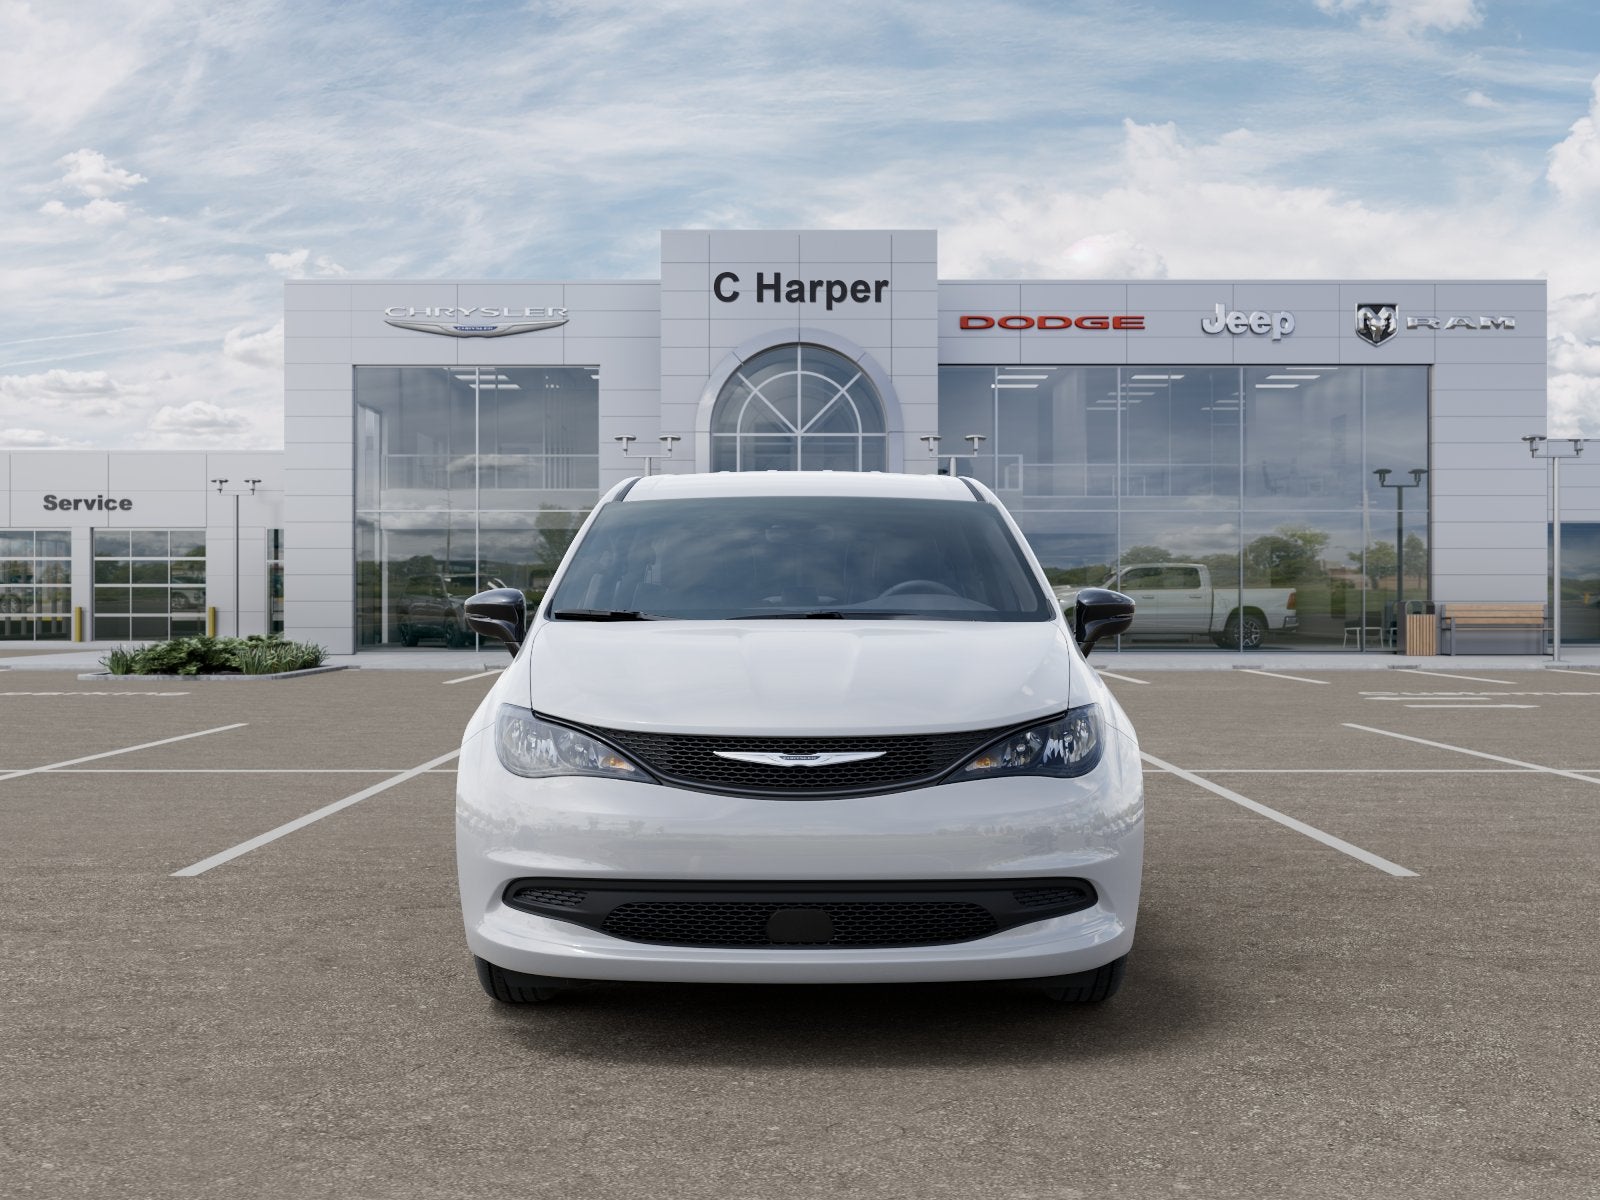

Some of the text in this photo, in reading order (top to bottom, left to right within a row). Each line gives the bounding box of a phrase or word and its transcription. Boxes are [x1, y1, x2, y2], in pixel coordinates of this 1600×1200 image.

[713, 271, 890, 311] C Harper
[384, 306, 570, 317] CHRYSLER
[959, 315, 1146, 330] DODGE
[1201, 302, 1296, 342] Jeep
[1406, 315, 1516, 331] RAM
[43, 494, 133, 512] Service
